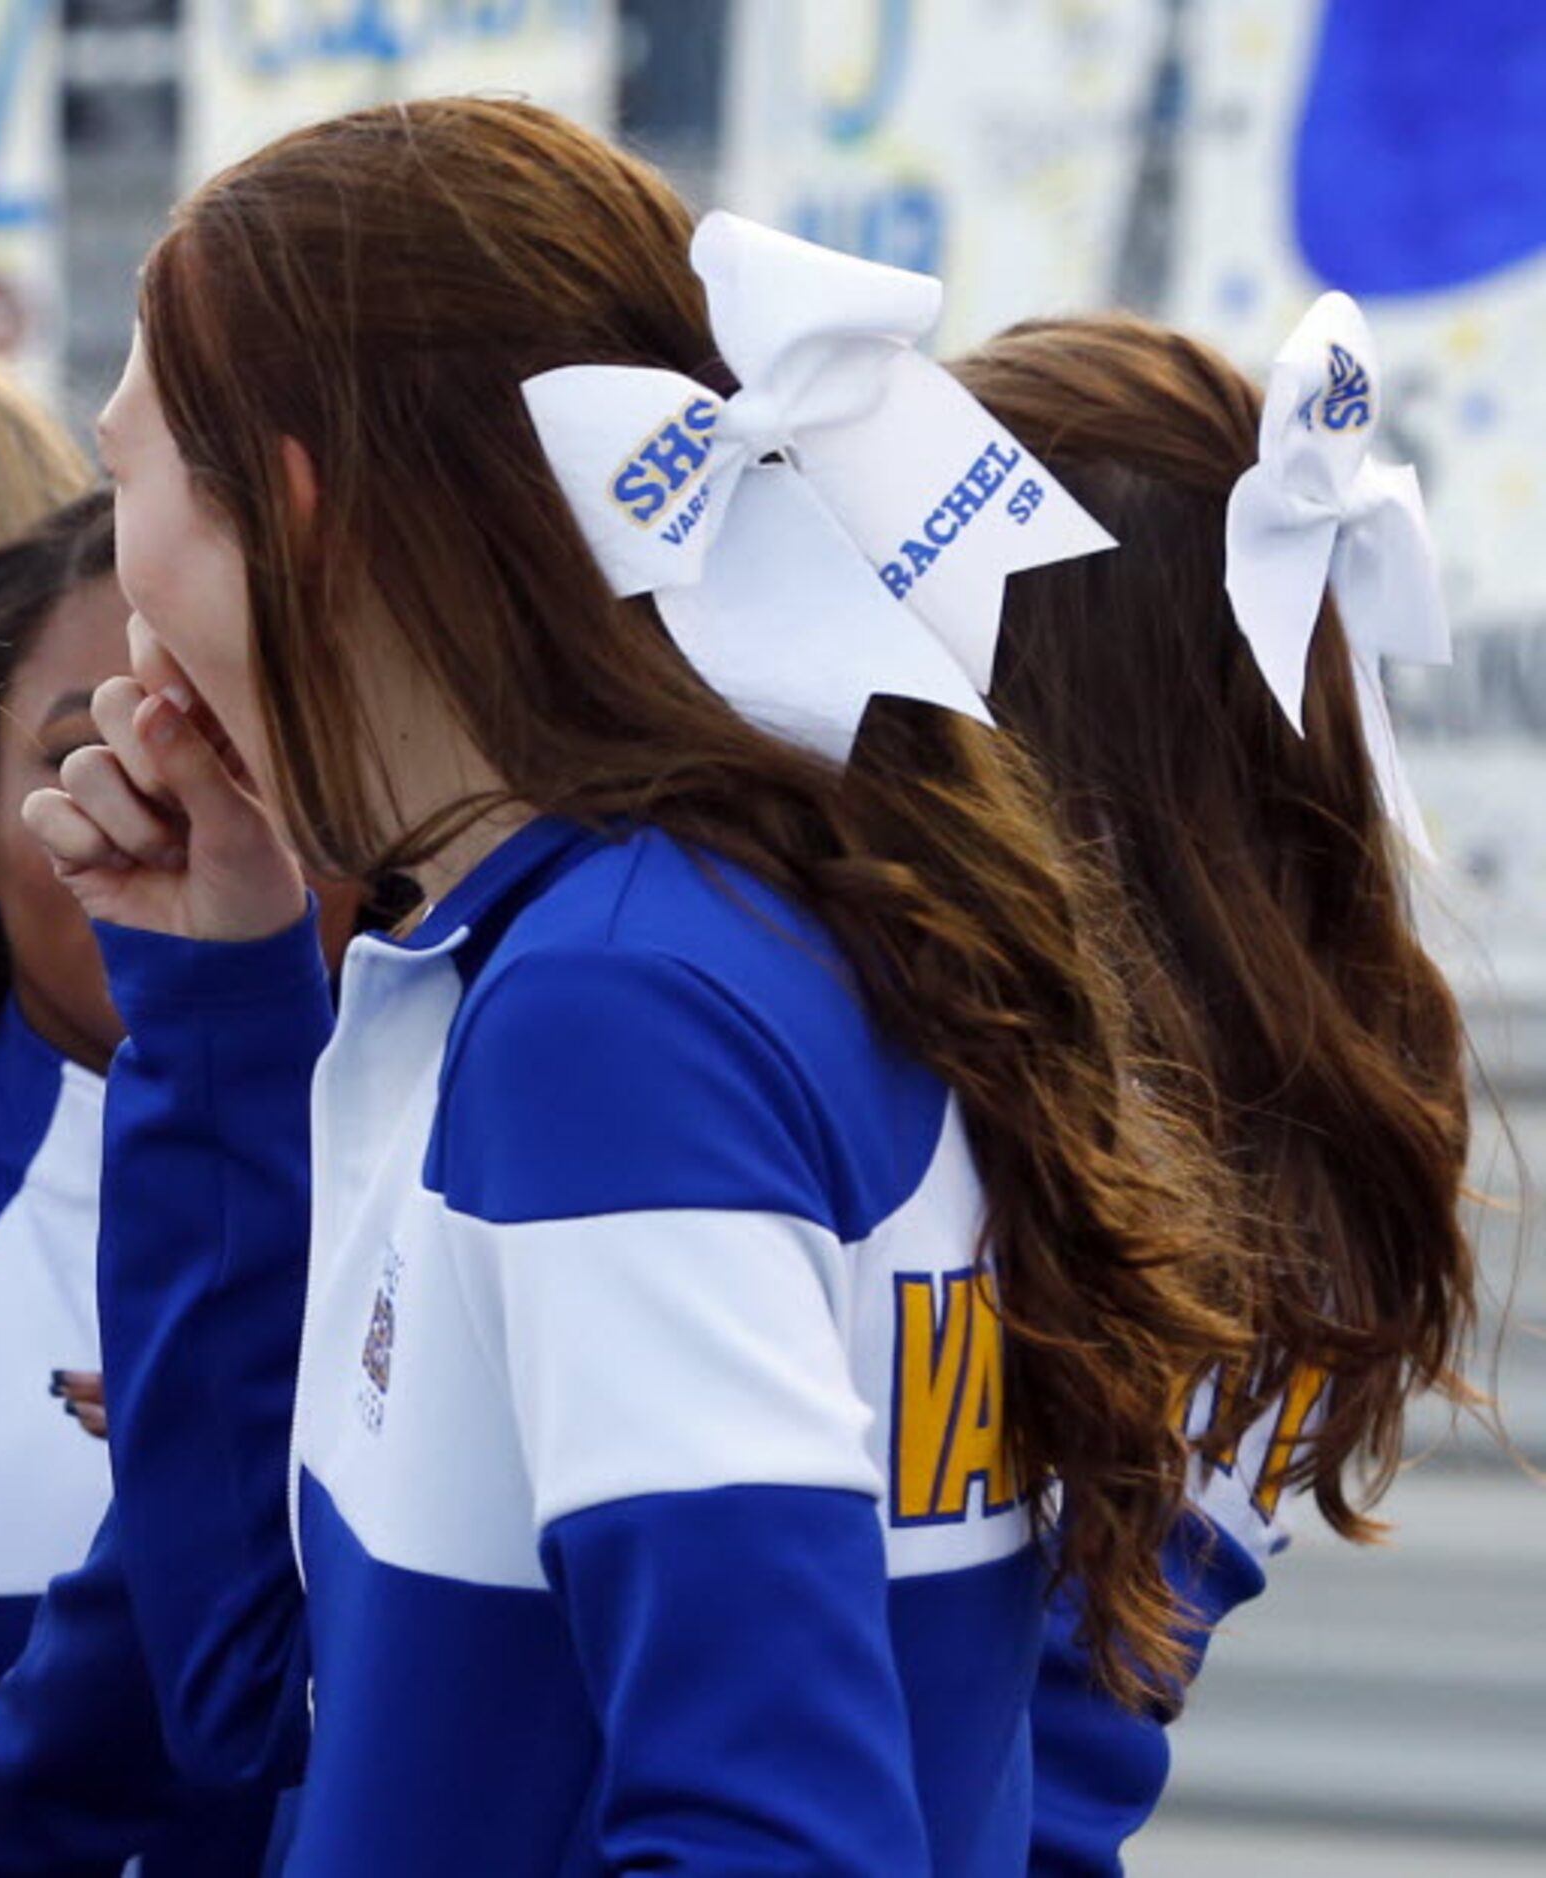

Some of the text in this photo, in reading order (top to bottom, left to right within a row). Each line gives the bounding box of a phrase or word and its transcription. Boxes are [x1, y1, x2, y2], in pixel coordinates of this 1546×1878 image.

[612, 398, 718, 523] SHS
[878, 440, 1022, 601] RACHEL
[1006, 478, 1045, 526] SR
